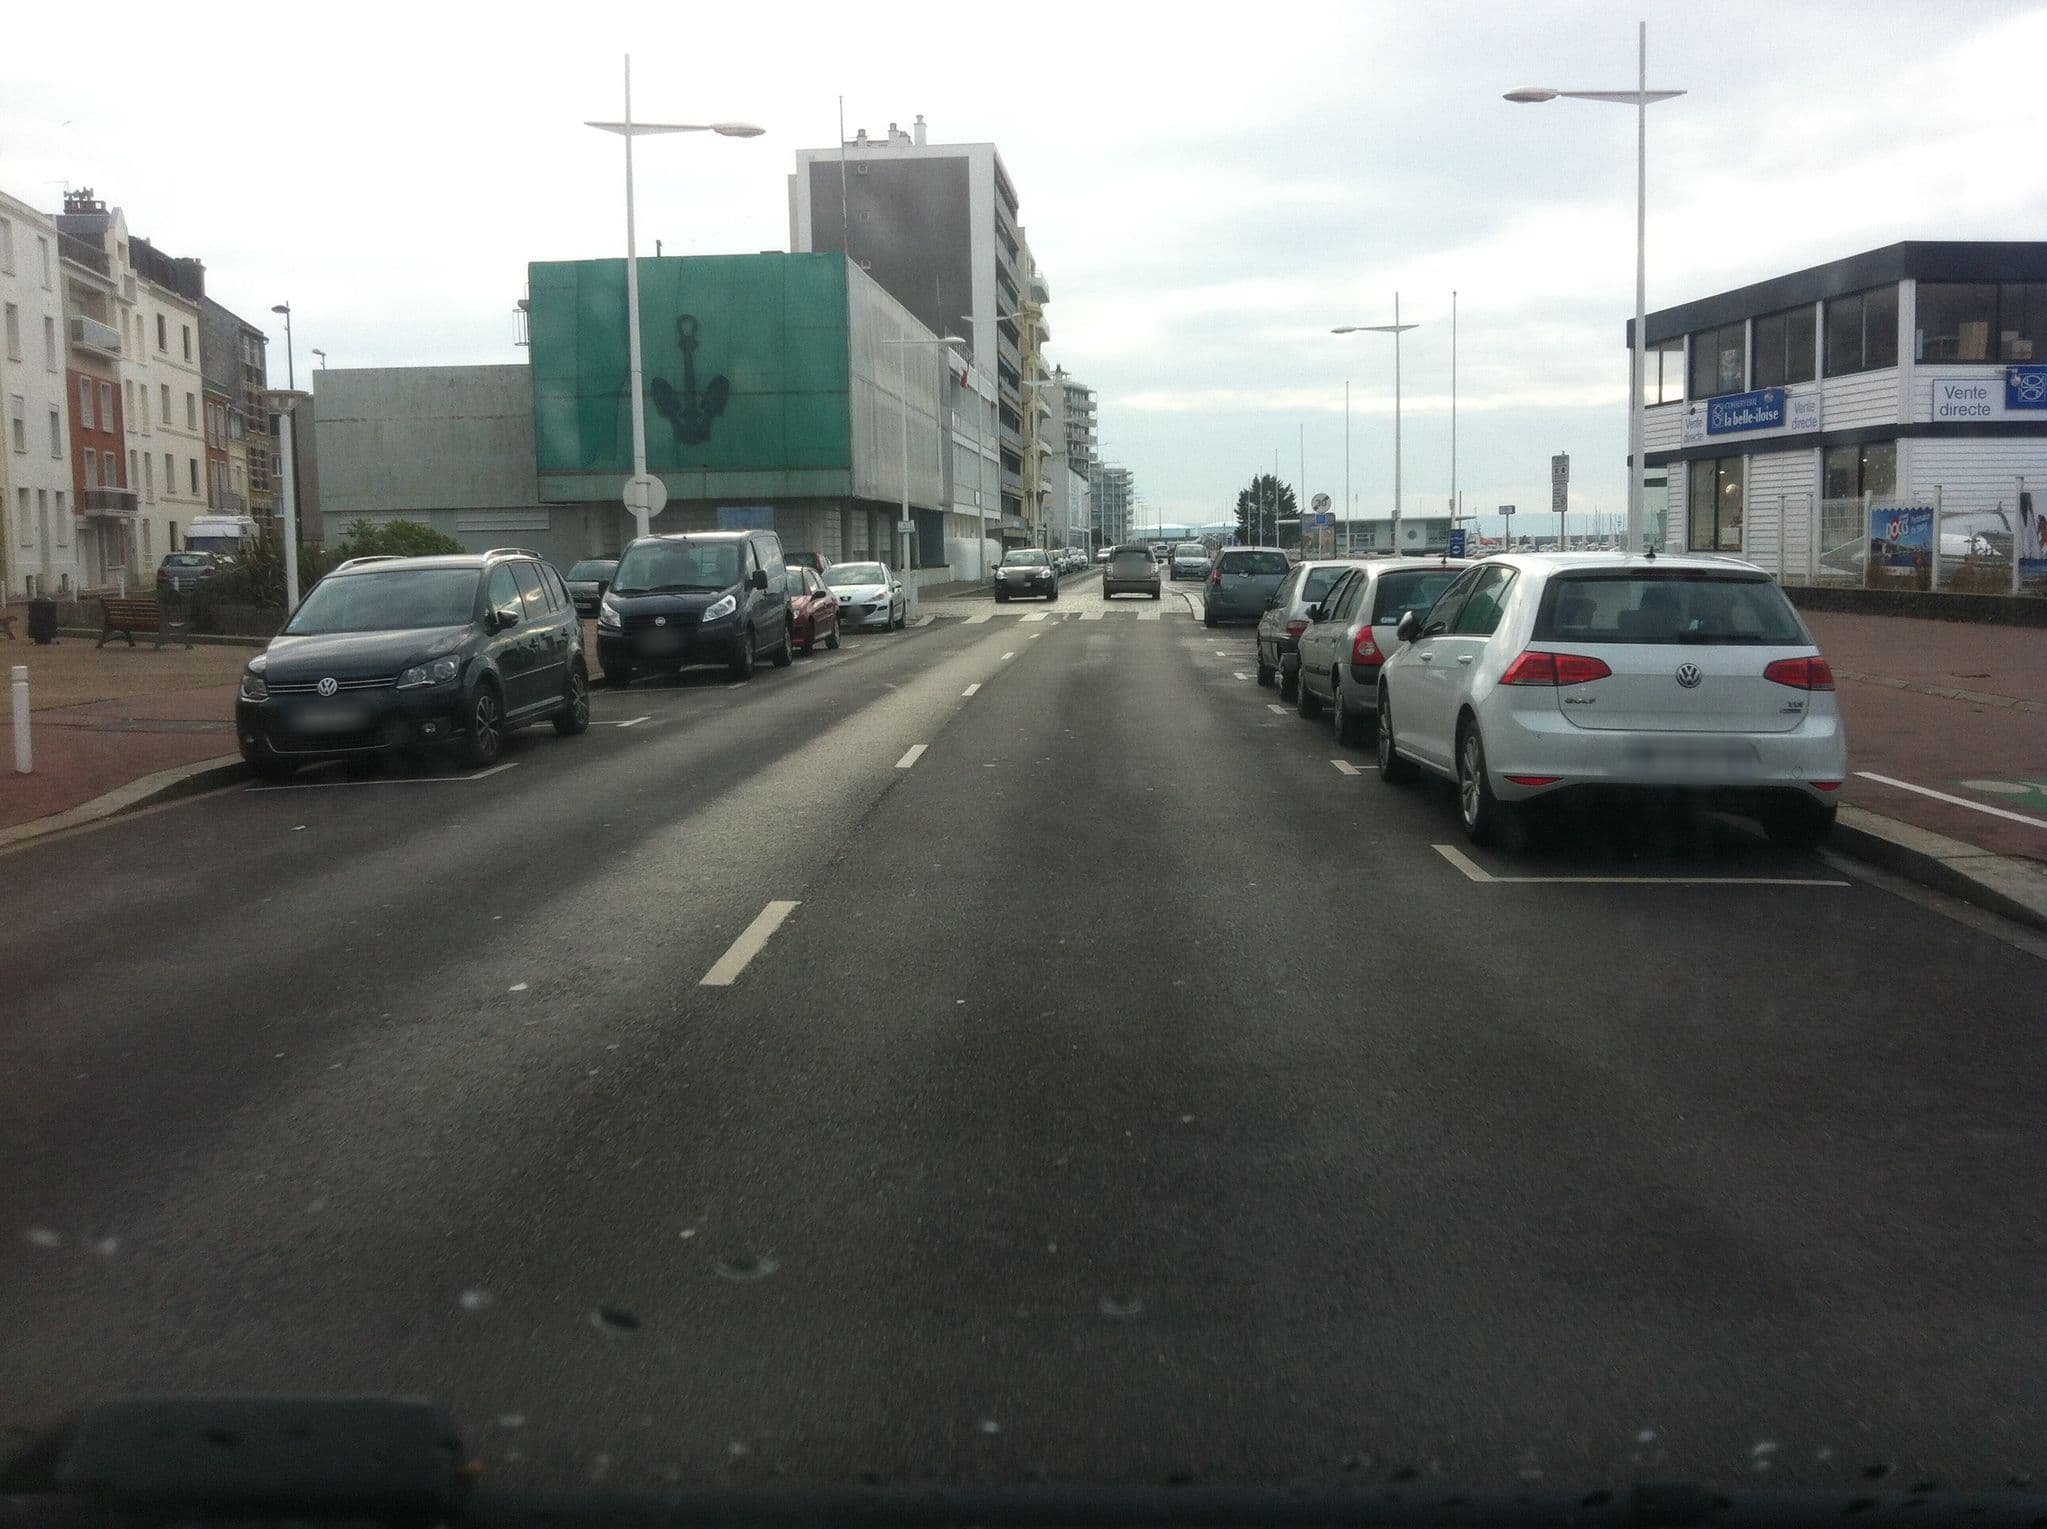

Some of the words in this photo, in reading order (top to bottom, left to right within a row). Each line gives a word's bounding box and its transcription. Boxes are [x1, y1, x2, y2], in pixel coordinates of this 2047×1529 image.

[1944, 386, 1987, 400] Vente
[1939, 403, 1991, 417] directe
[1724, 411, 1732, 427] la
